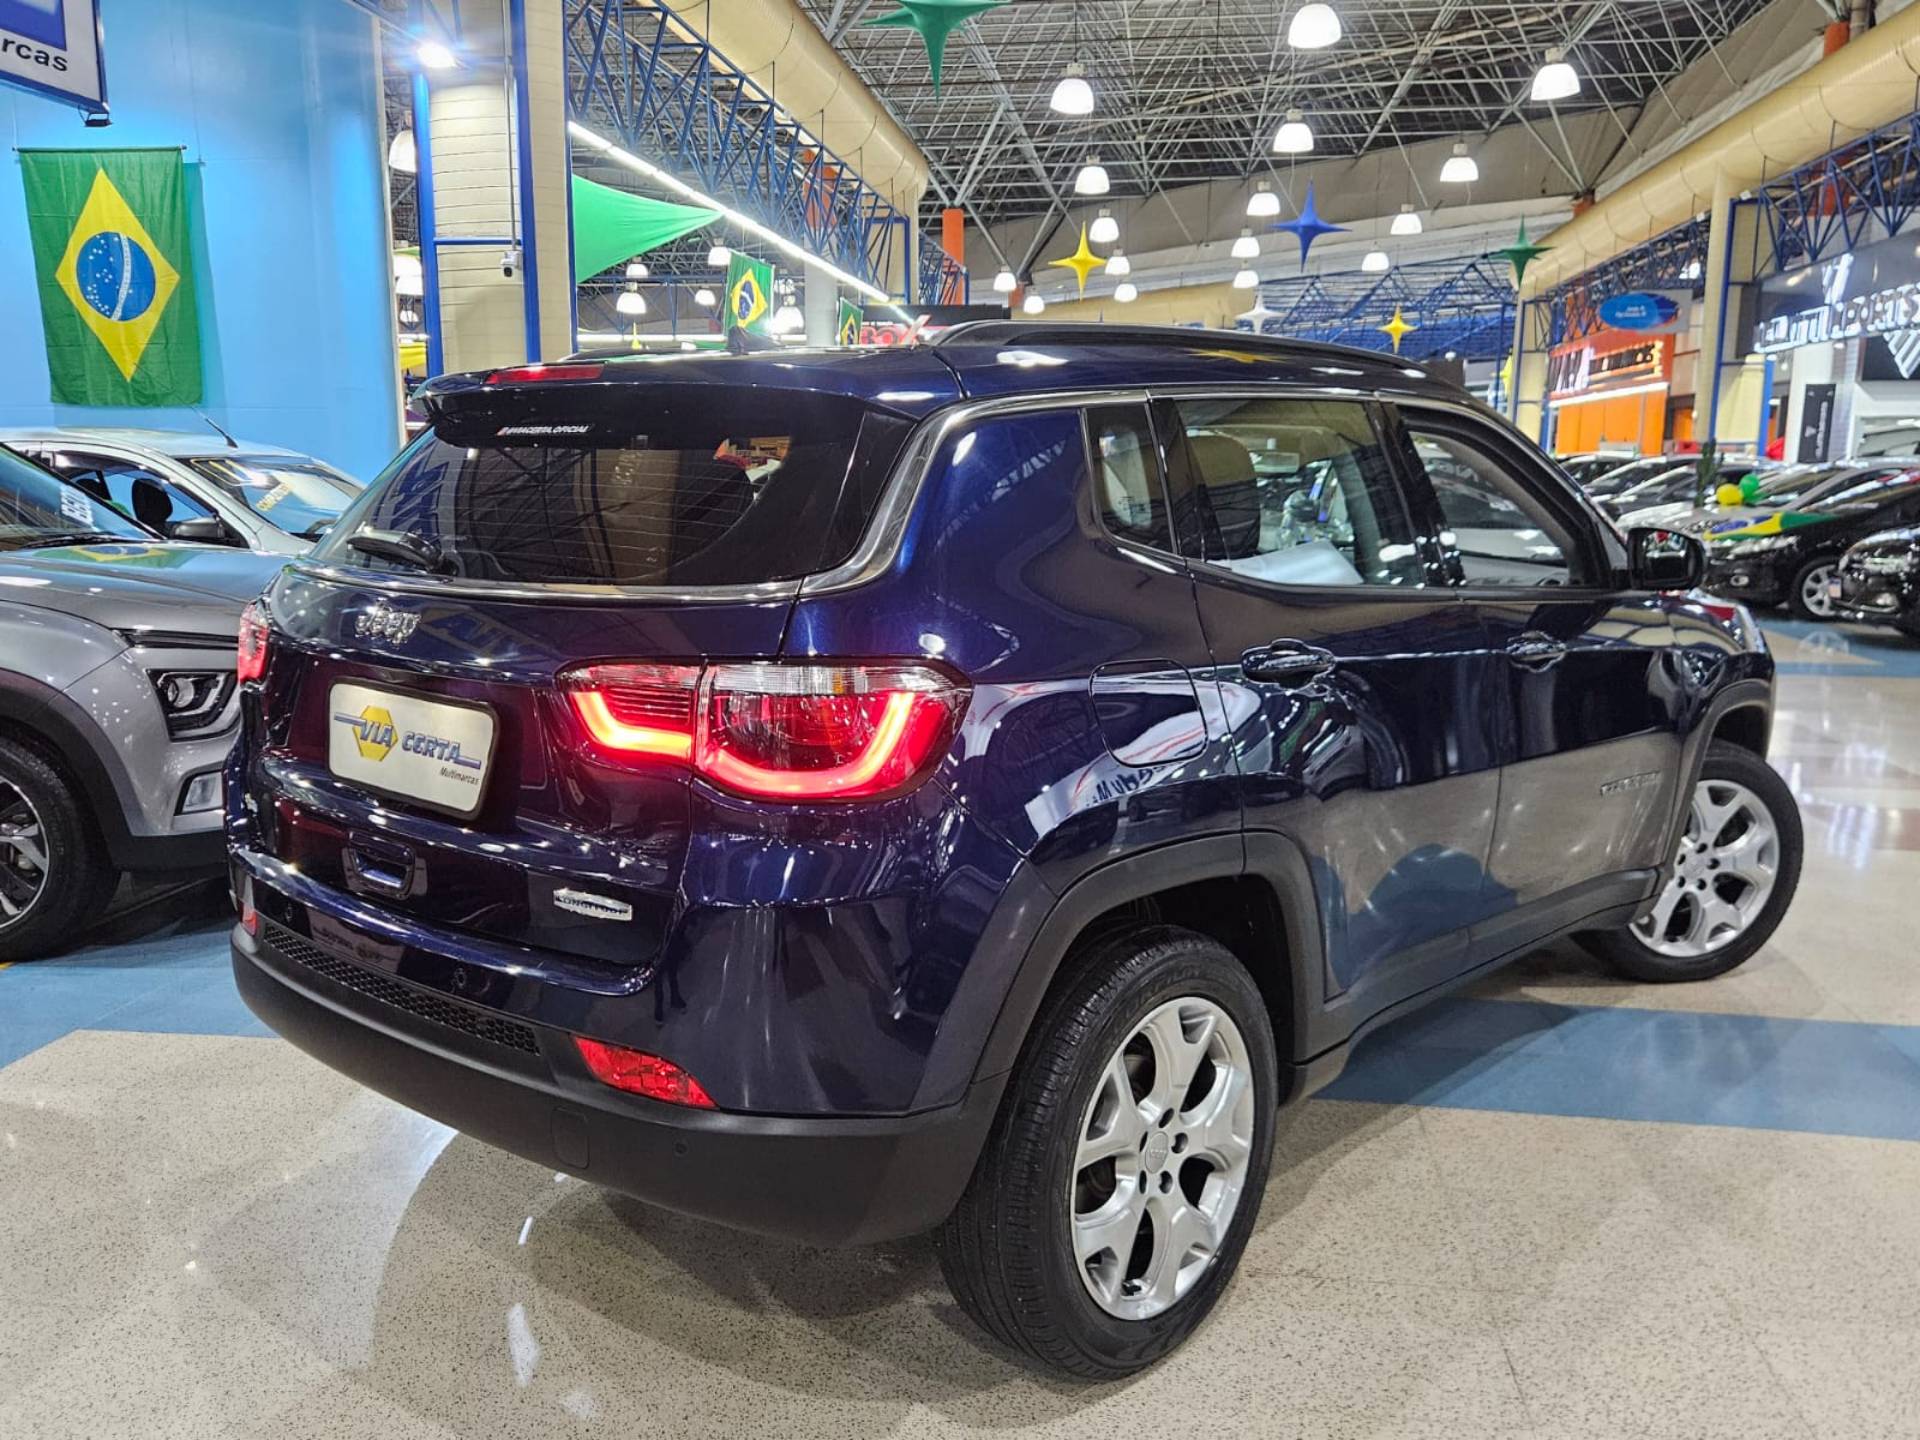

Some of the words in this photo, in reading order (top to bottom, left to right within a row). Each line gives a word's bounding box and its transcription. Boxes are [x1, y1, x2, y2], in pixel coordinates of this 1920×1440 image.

[2, 38, 68, 72] rcas
[358, 719, 394, 748] VIA
[401, 731, 461, 763] CERTA
